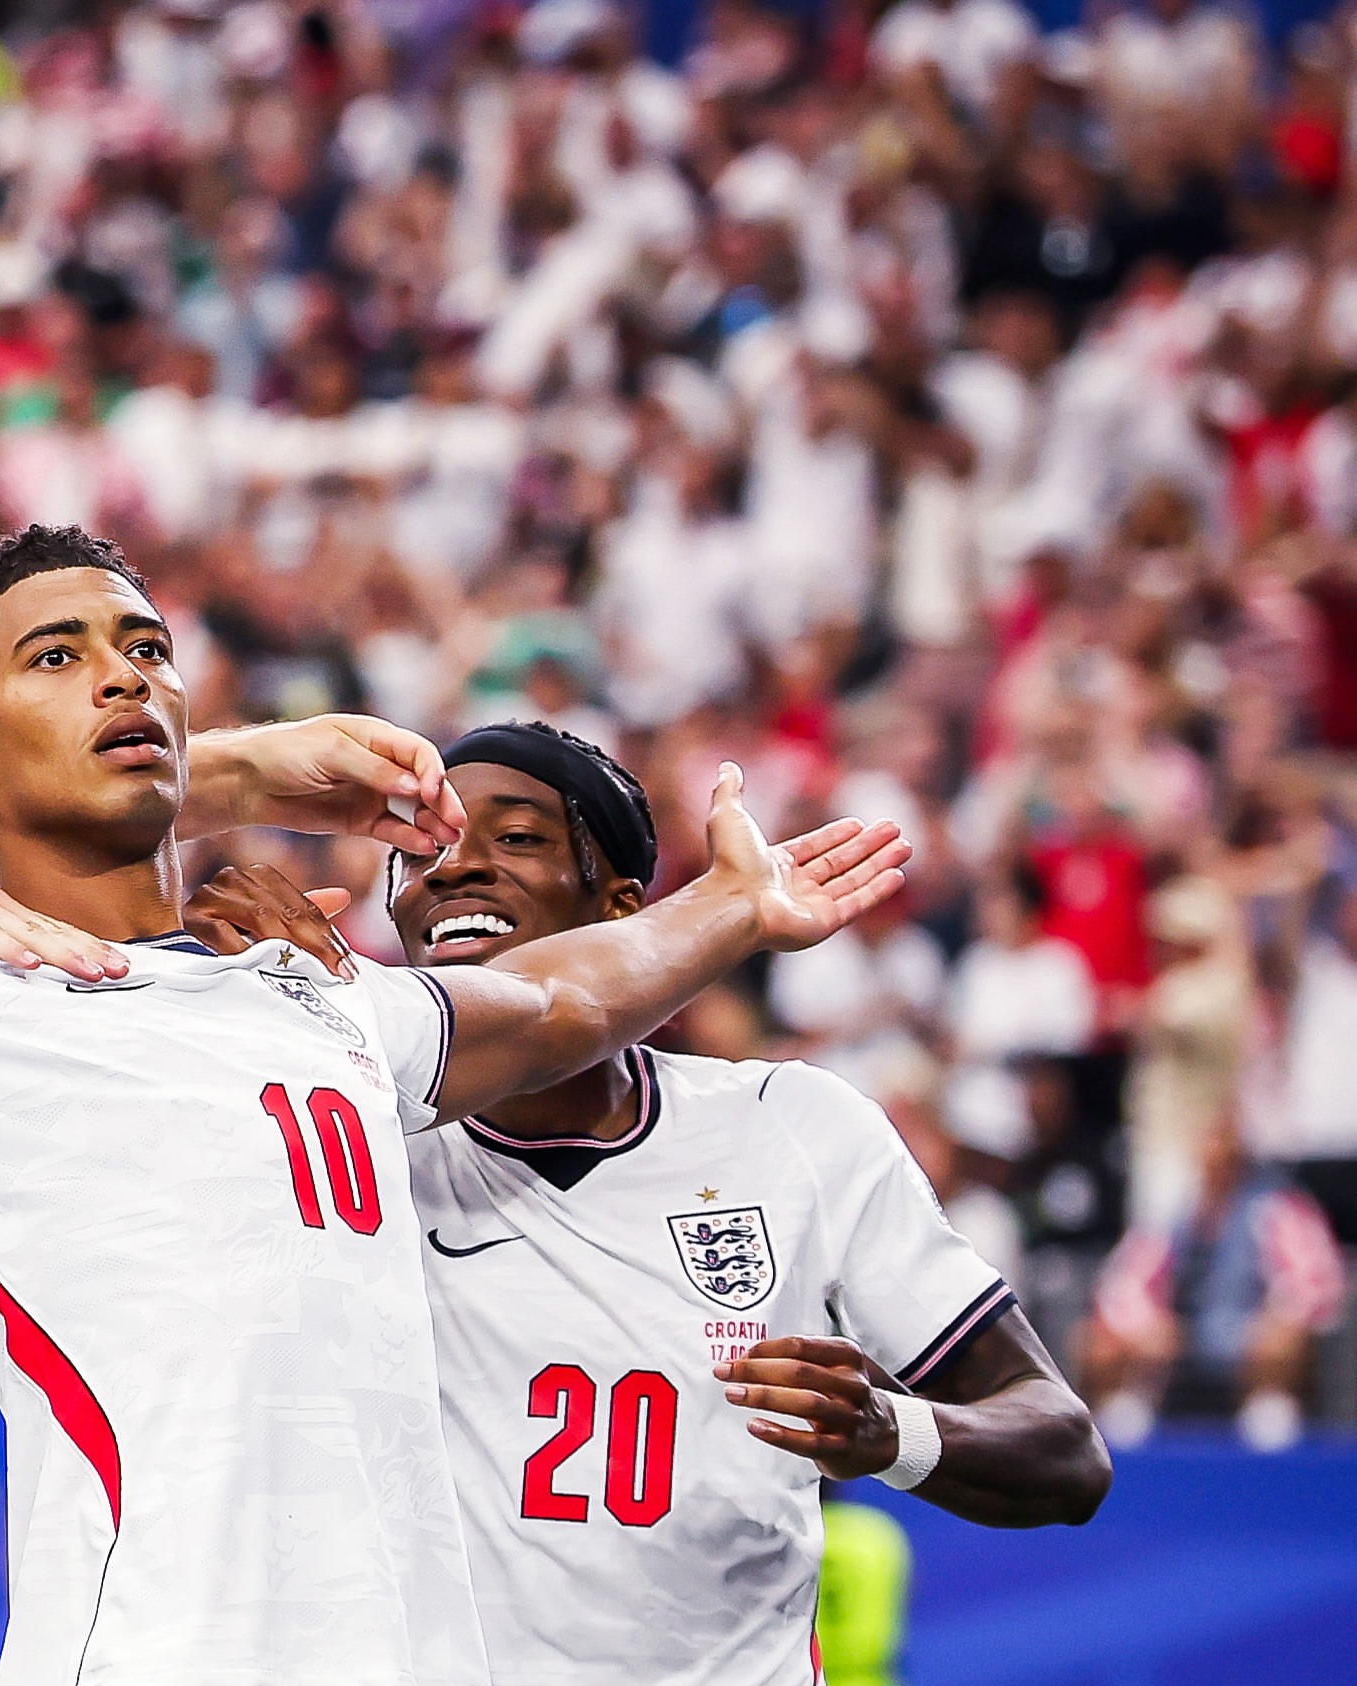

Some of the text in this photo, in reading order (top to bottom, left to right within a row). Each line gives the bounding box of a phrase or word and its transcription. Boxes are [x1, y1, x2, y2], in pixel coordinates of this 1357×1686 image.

[259, 1082, 383, 1237] 10
[704, 1321, 768, 1342] CROATIA
[520, 1362, 680, 1529] 20
